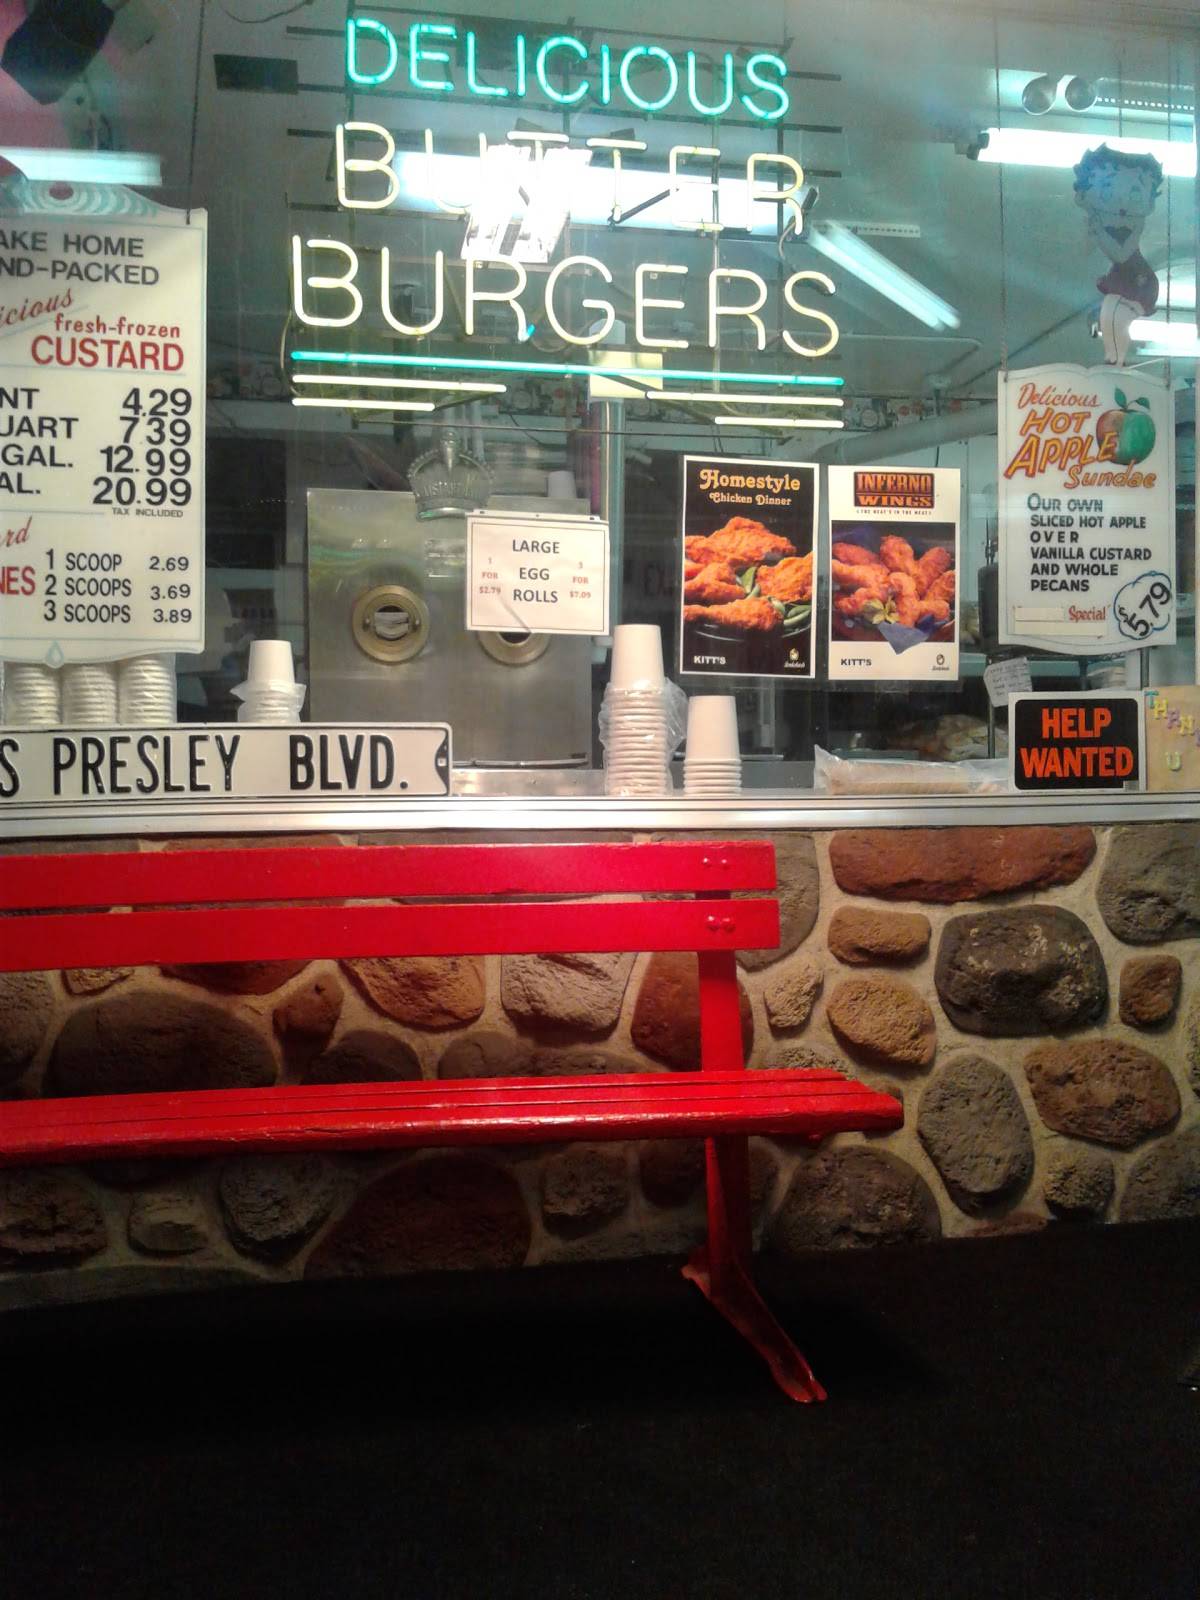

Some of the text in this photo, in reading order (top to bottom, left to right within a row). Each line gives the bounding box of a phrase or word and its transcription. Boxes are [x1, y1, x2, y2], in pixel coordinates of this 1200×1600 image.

[346, 18, 789, 120] DELICIOUS
[336, 122, 805, 235] BUTTER
[63, 234, 144, 258] HOME
[292, 234, 840, 358] BURGERS
[54, 313, 181, 338] fresh-frozen
[31, 335, 185, 371] CUSTARD
[122, 387, 192, 418] 4.29
[1017, 382, 1100, 410] Delicious
[1019, 408, 1092, 437] HOT
[2, 444, 192, 476] GAL. 12.99
[1004, 431, 1119, 479] APPLE
[699, 468, 801, 494] Homestyle
[857, 473, 932, 493] INFERNO
[1063, 460, 1157, 490] Sundae
[93, 476, 192, 506] 20.99
[709, 491, 792, 506] Chicken Dinner
[858, 495, 932, 507] WINGS
[1027, 493, 1103, 513] OUR OWN
[112, 507, 184, 518] TAX INCLUDED
[1030, 514, 1146, 529] SLICED HOT APPLE
[512, 539, 561, 554] LARGE
[1030, 531, 1080, 544] OVER
[46, 549, 189, 571] 1 SCOOP 2.69
[1030, 546, 1152, 561] VANILLA CUSTARD
[519, 567, 550, 581] EGG
[1030, 563, 1118, 577] AND WHOLE
[45, 574, 190, 600] 2 SCOOPS 3.69
[513, 589, 559, 604] ROLLS
[1031, 578, 1090, 593] PECANS
[44, 600, 192, 624] 3 SCOOPS 3.89
[1068, 604, 1107, 623] Special
[693, 655, 727, 665] KITT'S
[840, 658, 872, 666] KITT'S
[1041, 707, 1112, 739] HELP
[53, 734, 241, 795] PRESLEY
[289, 734, 410, 791] BLVD.
[1020, 745, 1134, 778] WANTED
